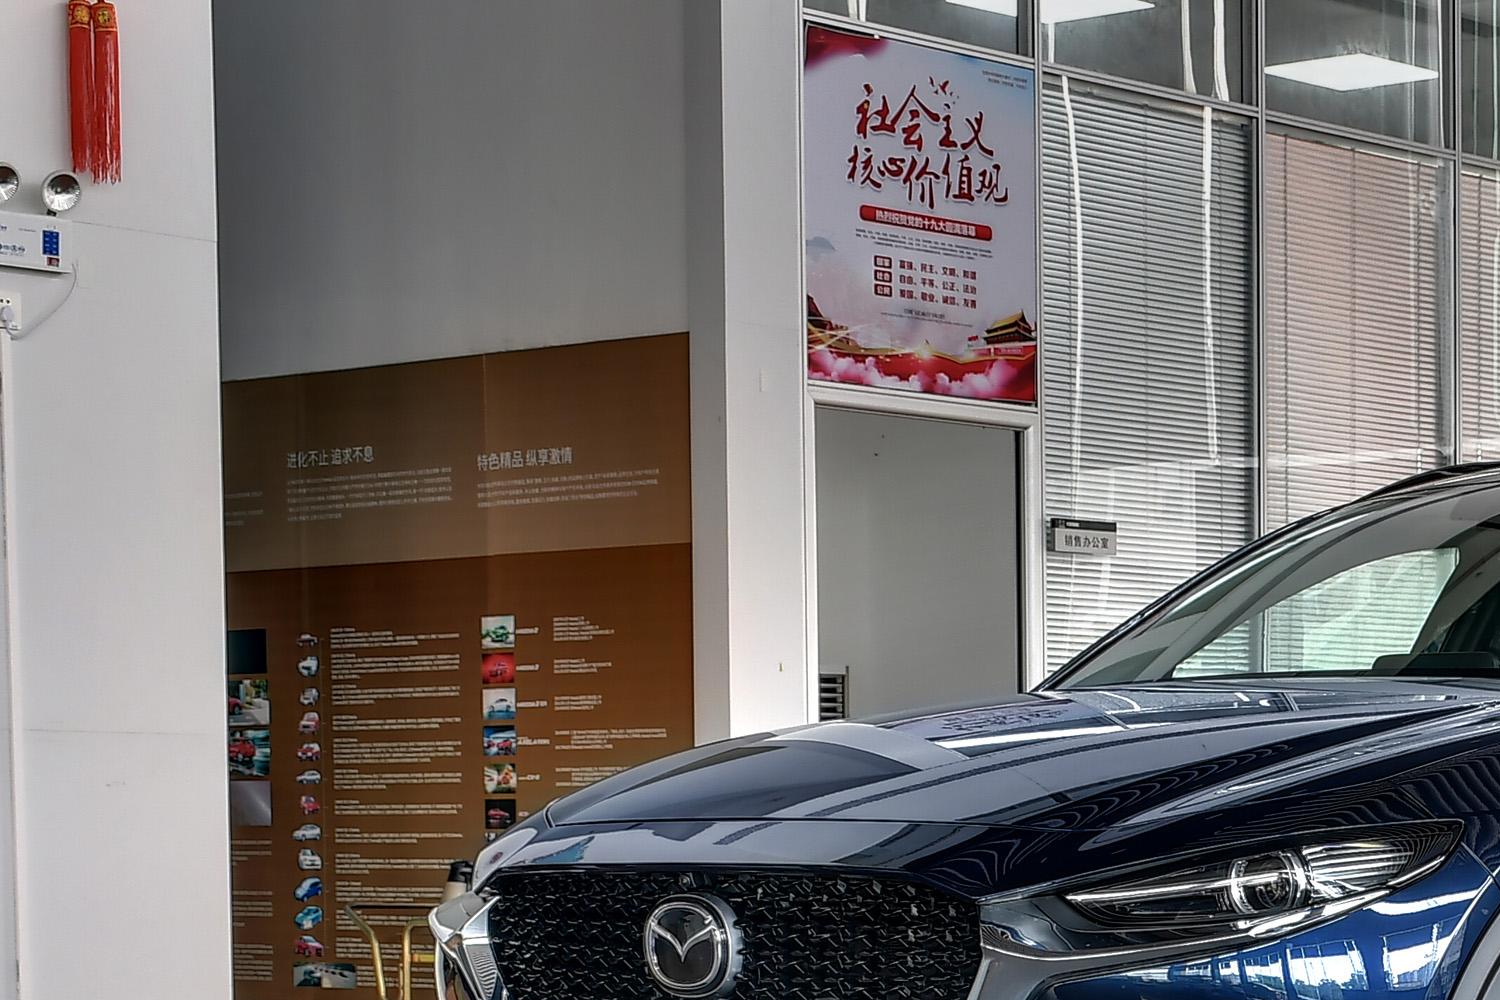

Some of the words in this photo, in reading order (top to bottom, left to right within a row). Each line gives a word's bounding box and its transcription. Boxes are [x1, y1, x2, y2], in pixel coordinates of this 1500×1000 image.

[856, 83, 994, 157] 社会主义
[847, 145, 1009, 210] 核心价值观
[478, 450, 524, 471] 特色精品
[526, 447, 572, 467] 纵享激情
[1065, 534, 1109, 549] 销售办公室
